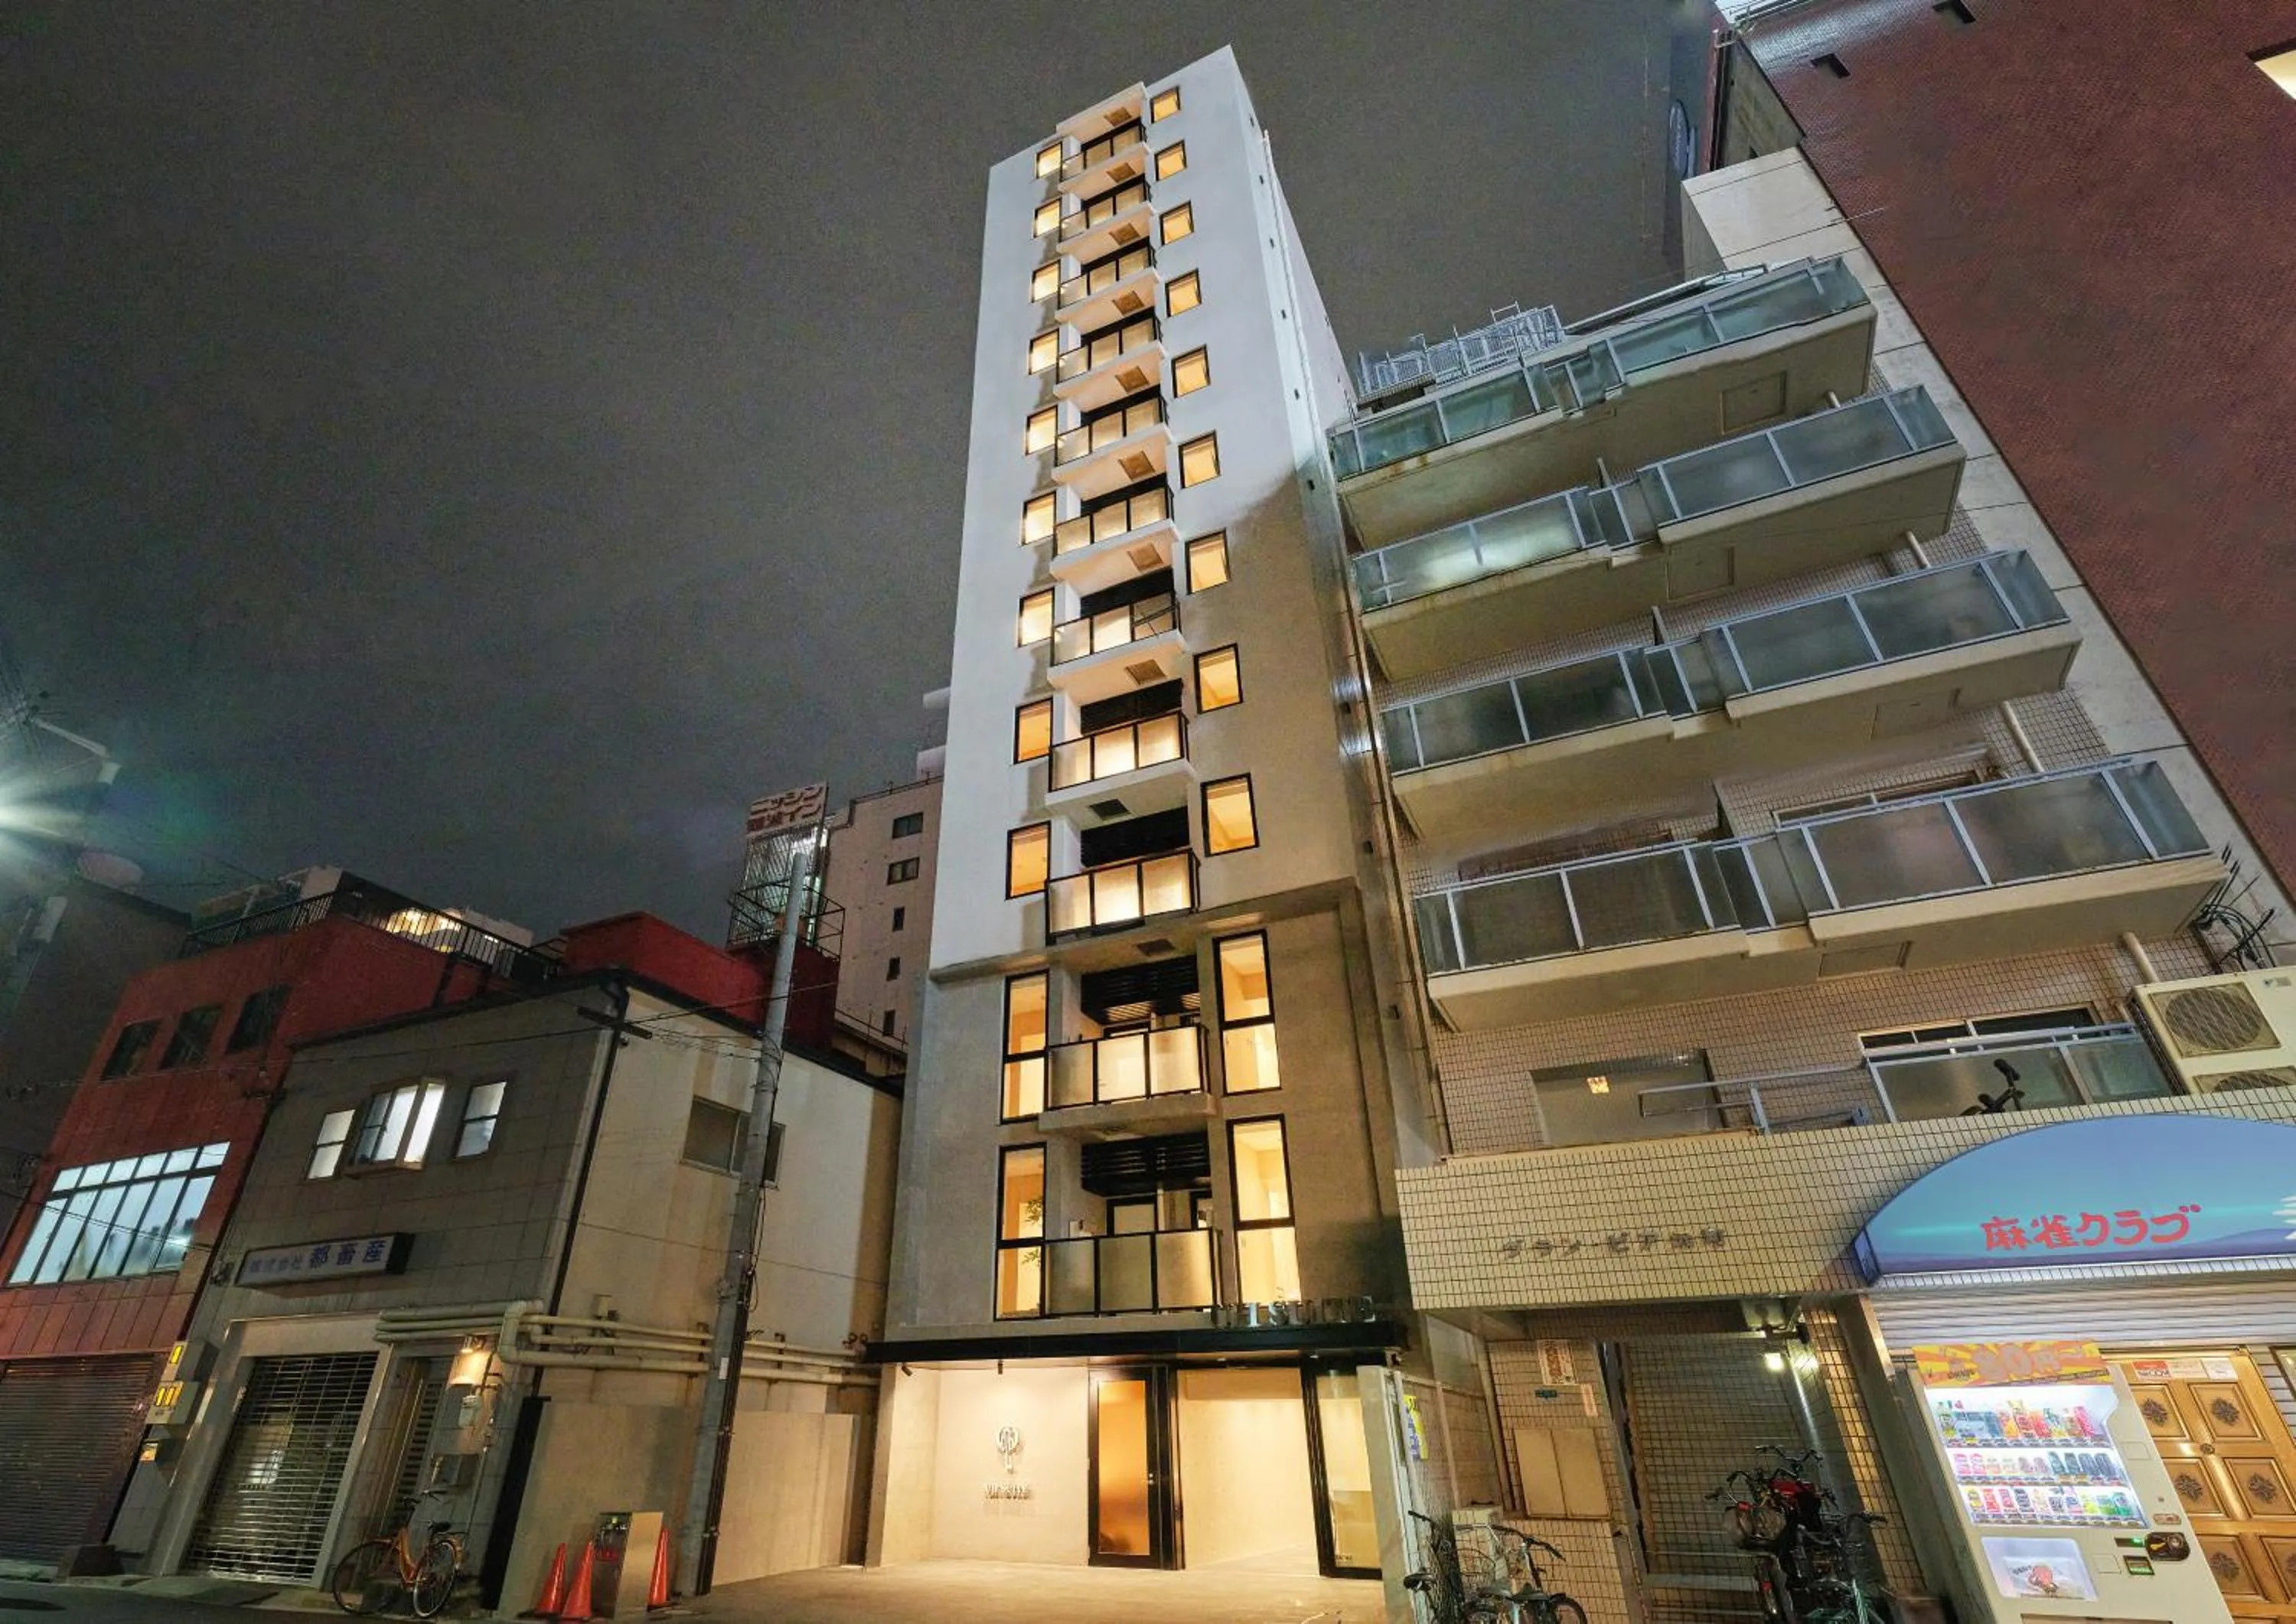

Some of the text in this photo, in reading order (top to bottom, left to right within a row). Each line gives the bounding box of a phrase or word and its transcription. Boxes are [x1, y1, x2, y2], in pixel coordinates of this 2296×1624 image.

[750, 786, 824, 815] ニッシン
[1981, 1205, 2201, 1251] 麻雀クラブ
